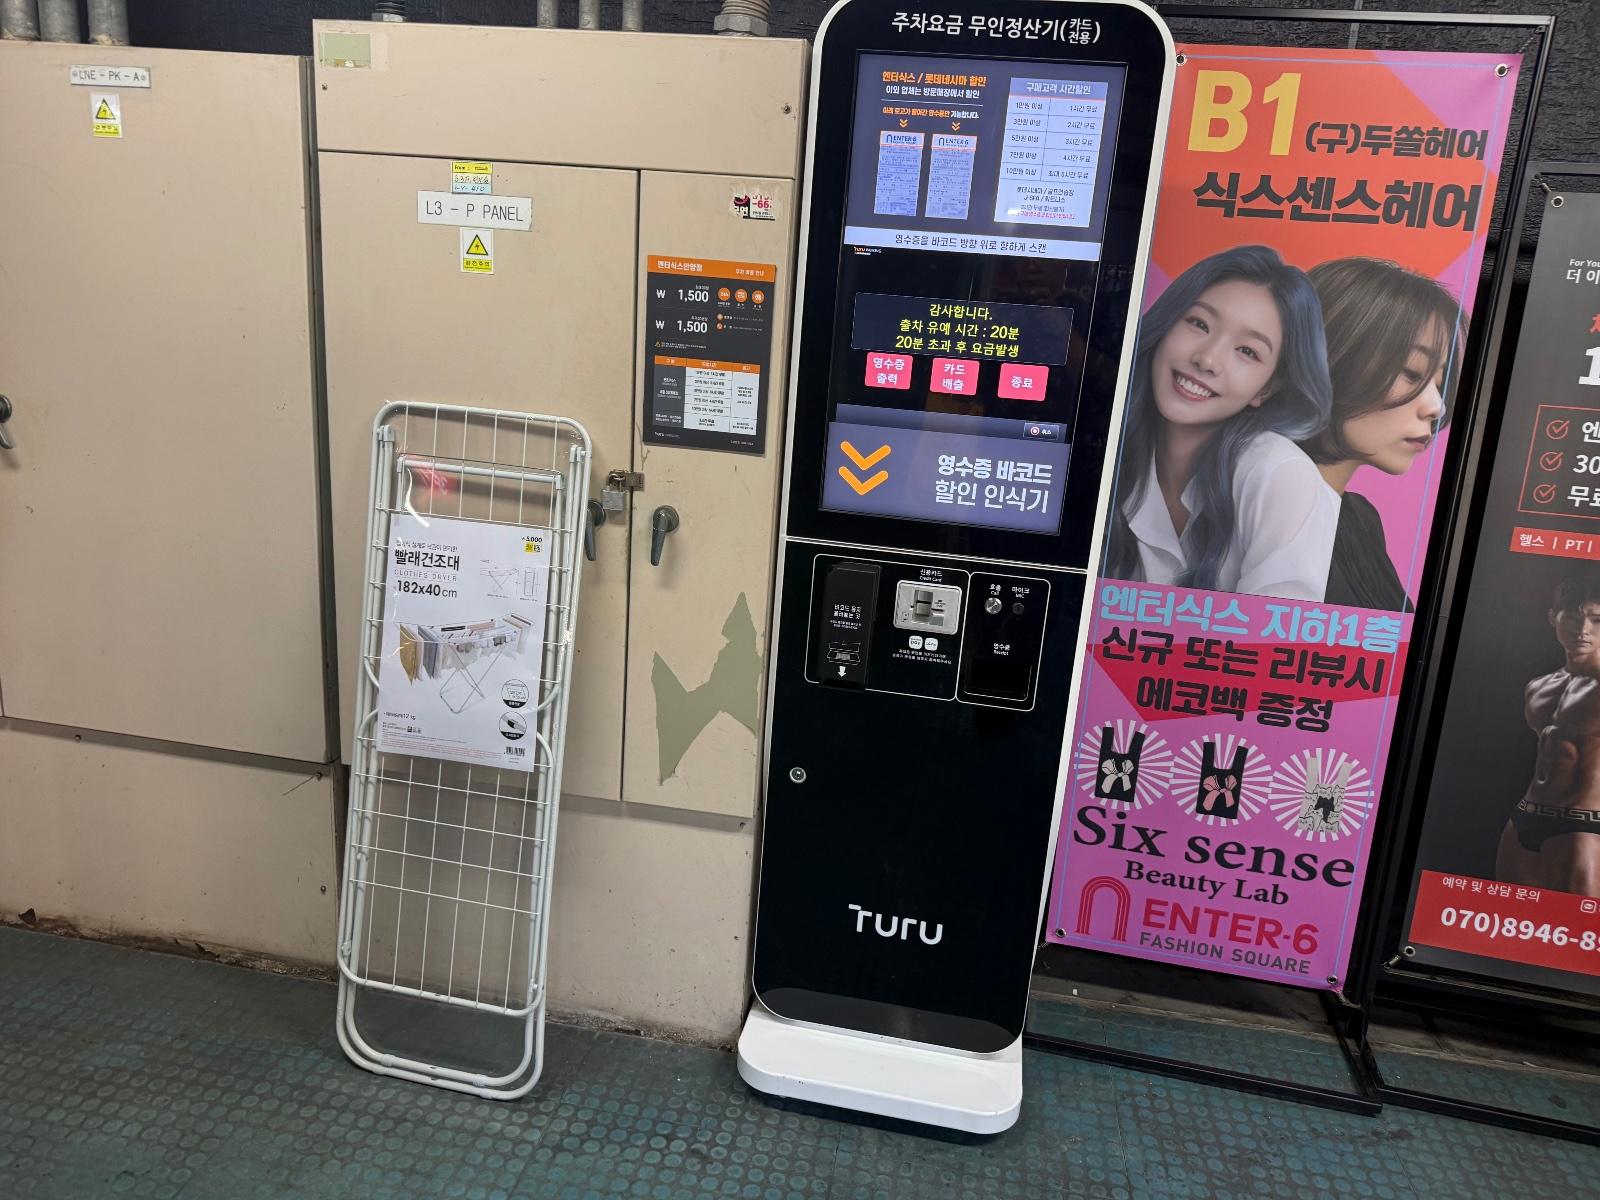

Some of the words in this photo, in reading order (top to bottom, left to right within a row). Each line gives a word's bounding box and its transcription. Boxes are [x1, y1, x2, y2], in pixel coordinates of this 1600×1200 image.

[891, 12, 964, 35] 주차요금
[108, 71, 121, 80] PK
[882, 71, 915, 83] 엔터식스
[969, 75, 986, 87] 할인
[886, 85, 899, 94] 이외
[966, 89, 979, 98] 할인
[1026, 82, 1057, 93] 구매고객
[1059, 84, 1091, 95] 시간할인
[1187, 69, 1302, 156] B1
[1193, 171, 1483, 232] 식스센스헤어
[426, 200, 442, 216] L3
[466, 203, 475, 218] P
[482, 204, 524, 222] PANEL
[895, 233, 928, 246] 영수증을
[931, 236, 957, 247] 바코드
[960, 238, 978, 249] 방향
[980, 239, 997, 250] 위로
[1000, 240, 1026, 252] 향하게
[1028, 241, 1047, 254] 스캔
[1569, 258, 1585, 267] For
[1566, 268, 1581, 284] 더
[678, 288, 709, 303] 1,500
[929, 303, 993, 320] 감사합니다.
[677, 319, 708, 334] 1,500
[899, 319, 923, 334] 출차
[926, 322, 951, 336] 유예
[954, 323, 979, 338] 시간
[990, 325, 1020, 340] 20분
[895, 336, 924, 350] 20분
[927, 338, 951, 353] 초과
[955, 340, 966, 353] 후
[970, 341, 1019, 358] 요금발생
[873, 357, 905, 371] 영수증
[943, 363, 966, 376] 카드
[876, 373, 898, 385] 출력
[942, 377, 965, 391] 배출
[1011, 375, 1033, 388] 종료
[938, 454, 992, 480] 영수증
[996, 459, 1053, 485] 바코드
[935, 479, 978, 507] 할인
[984, 484, 1049, 514] 인식기
[1519, 533, 1545, 547] 헬스
[1565, 539, 1584, 551] PT
[394, 549, 460, 572] 빨래건조대
[394, 568, 428, 579] CLOTHES
[432, 573, 457, 582] DRYER
[920, 568, 943, 577] 신용카드
[1011, 586, 1030, 594] 마이크
[1101, 584, 1251, 635] 엔터식스
[1260, 603, 1402, 654] 지하1층
[1102, 626, 1175, 665] 신규
[1183, 636, 1259, 678] 또는
[1269, 646, 1384, 694] 리뷰시
[1136, 676, 1248, 722] 에코백
[1256, 691, 1334, 733] 증정
[1073, 805, 1168, 858] Six
[1184, 834, 1355, 887] sense
[1123, 859, 1227, 900] Beauty
[1232, 878, 1289, 906] Lab
[1442, 876, 1467, 891] 예약
[1471, 880, 1483, 893] 및
[1486, 884, 1512, 898] 상담
[1515, 888, 1541, 903] 문의
[1441, 907, 1600, 953] 070)8946-8
[1139, 931, 1224, 960] FASHION
[1231, 948, 1312, 975] SQUARE
